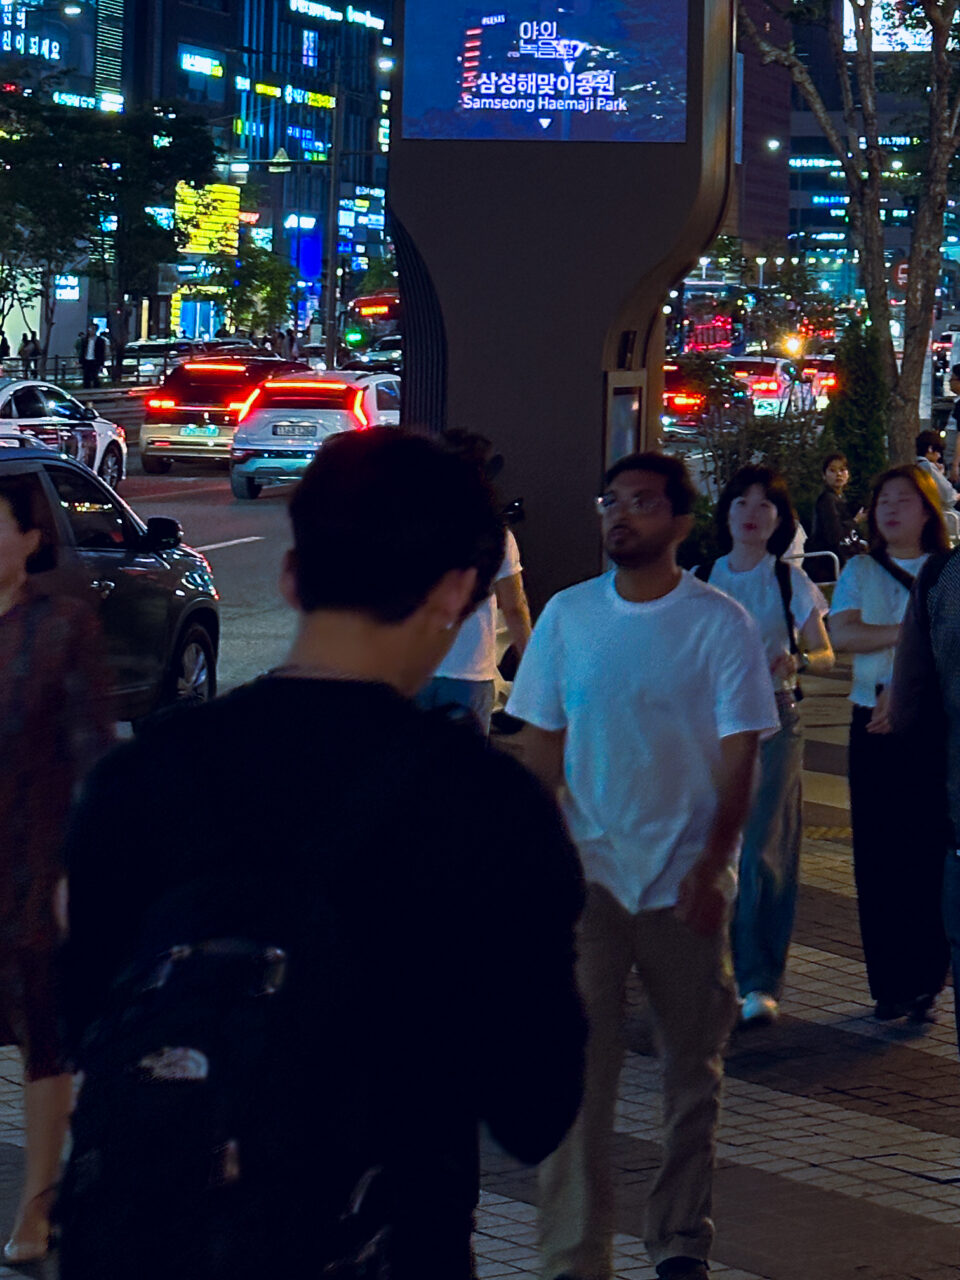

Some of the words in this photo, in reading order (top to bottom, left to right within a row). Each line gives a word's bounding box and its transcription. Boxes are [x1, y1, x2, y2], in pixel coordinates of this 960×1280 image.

[519, 20, 557, 40] 야외
[477, 71, 615, 96] 삼성해맞이공원
[463, 95, 536, 113] Samseong
[538, 96, 594, 114] Haemaji
[597, 98, 628, 112] Park
